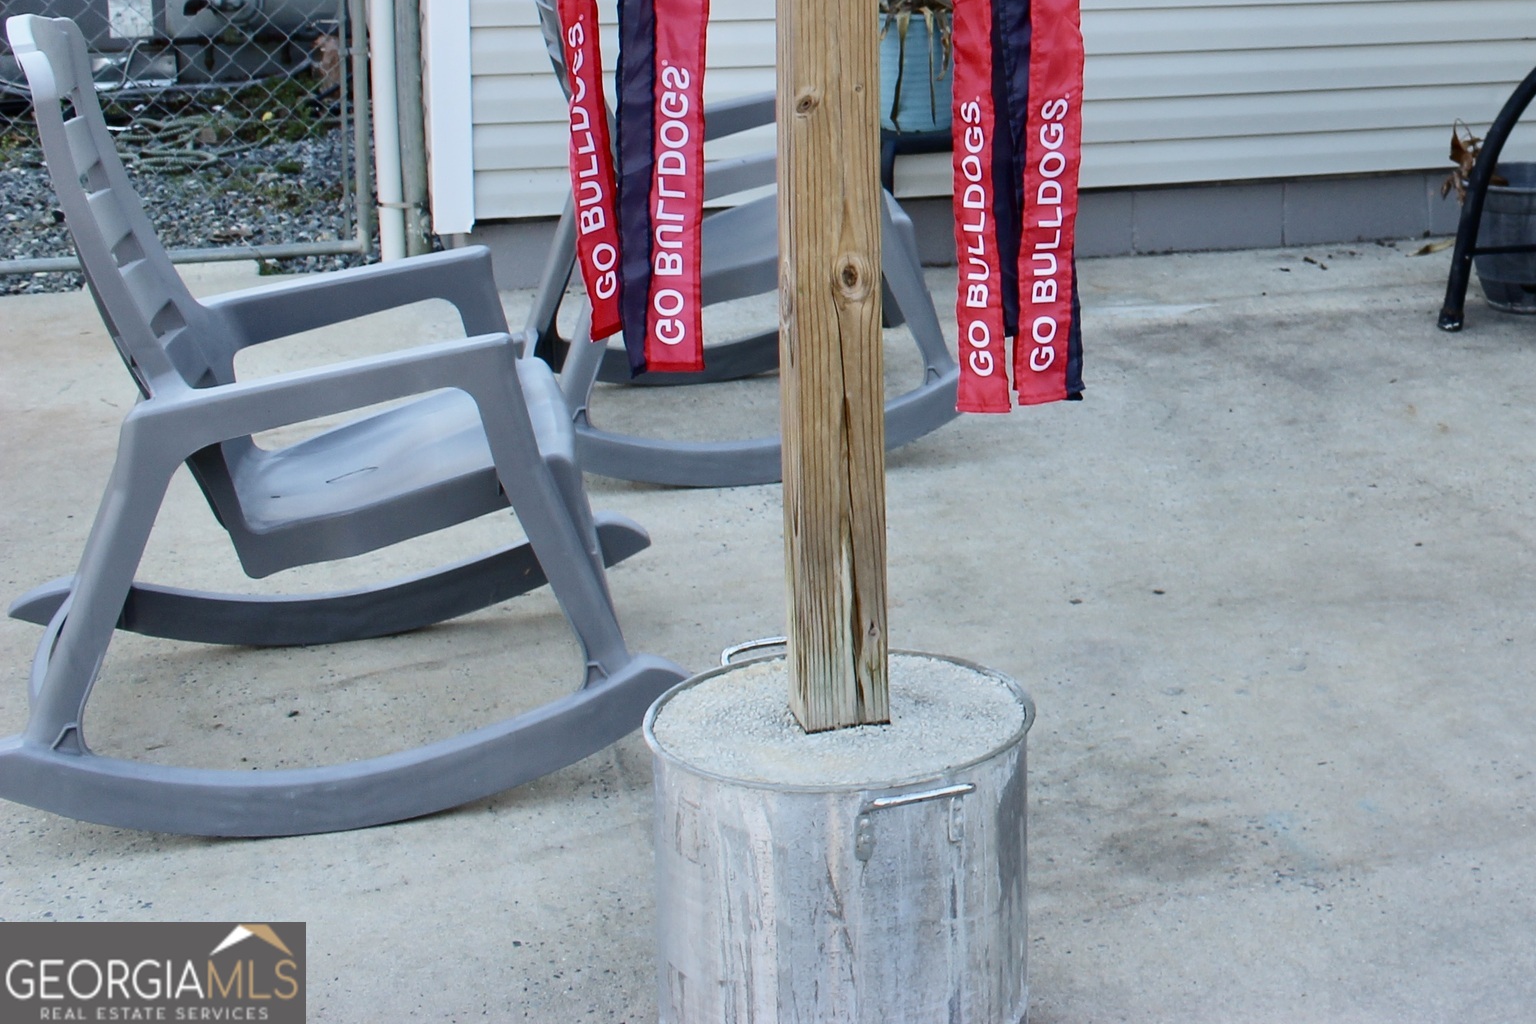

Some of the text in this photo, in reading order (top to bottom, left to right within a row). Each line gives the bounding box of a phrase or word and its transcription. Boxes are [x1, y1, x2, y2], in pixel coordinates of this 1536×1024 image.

[592, 243, 617, 300] GO
[960, 101, 995, 376] GO BULLDOGS
[1029, 100, 1069, 372] GO BULLDOGS
